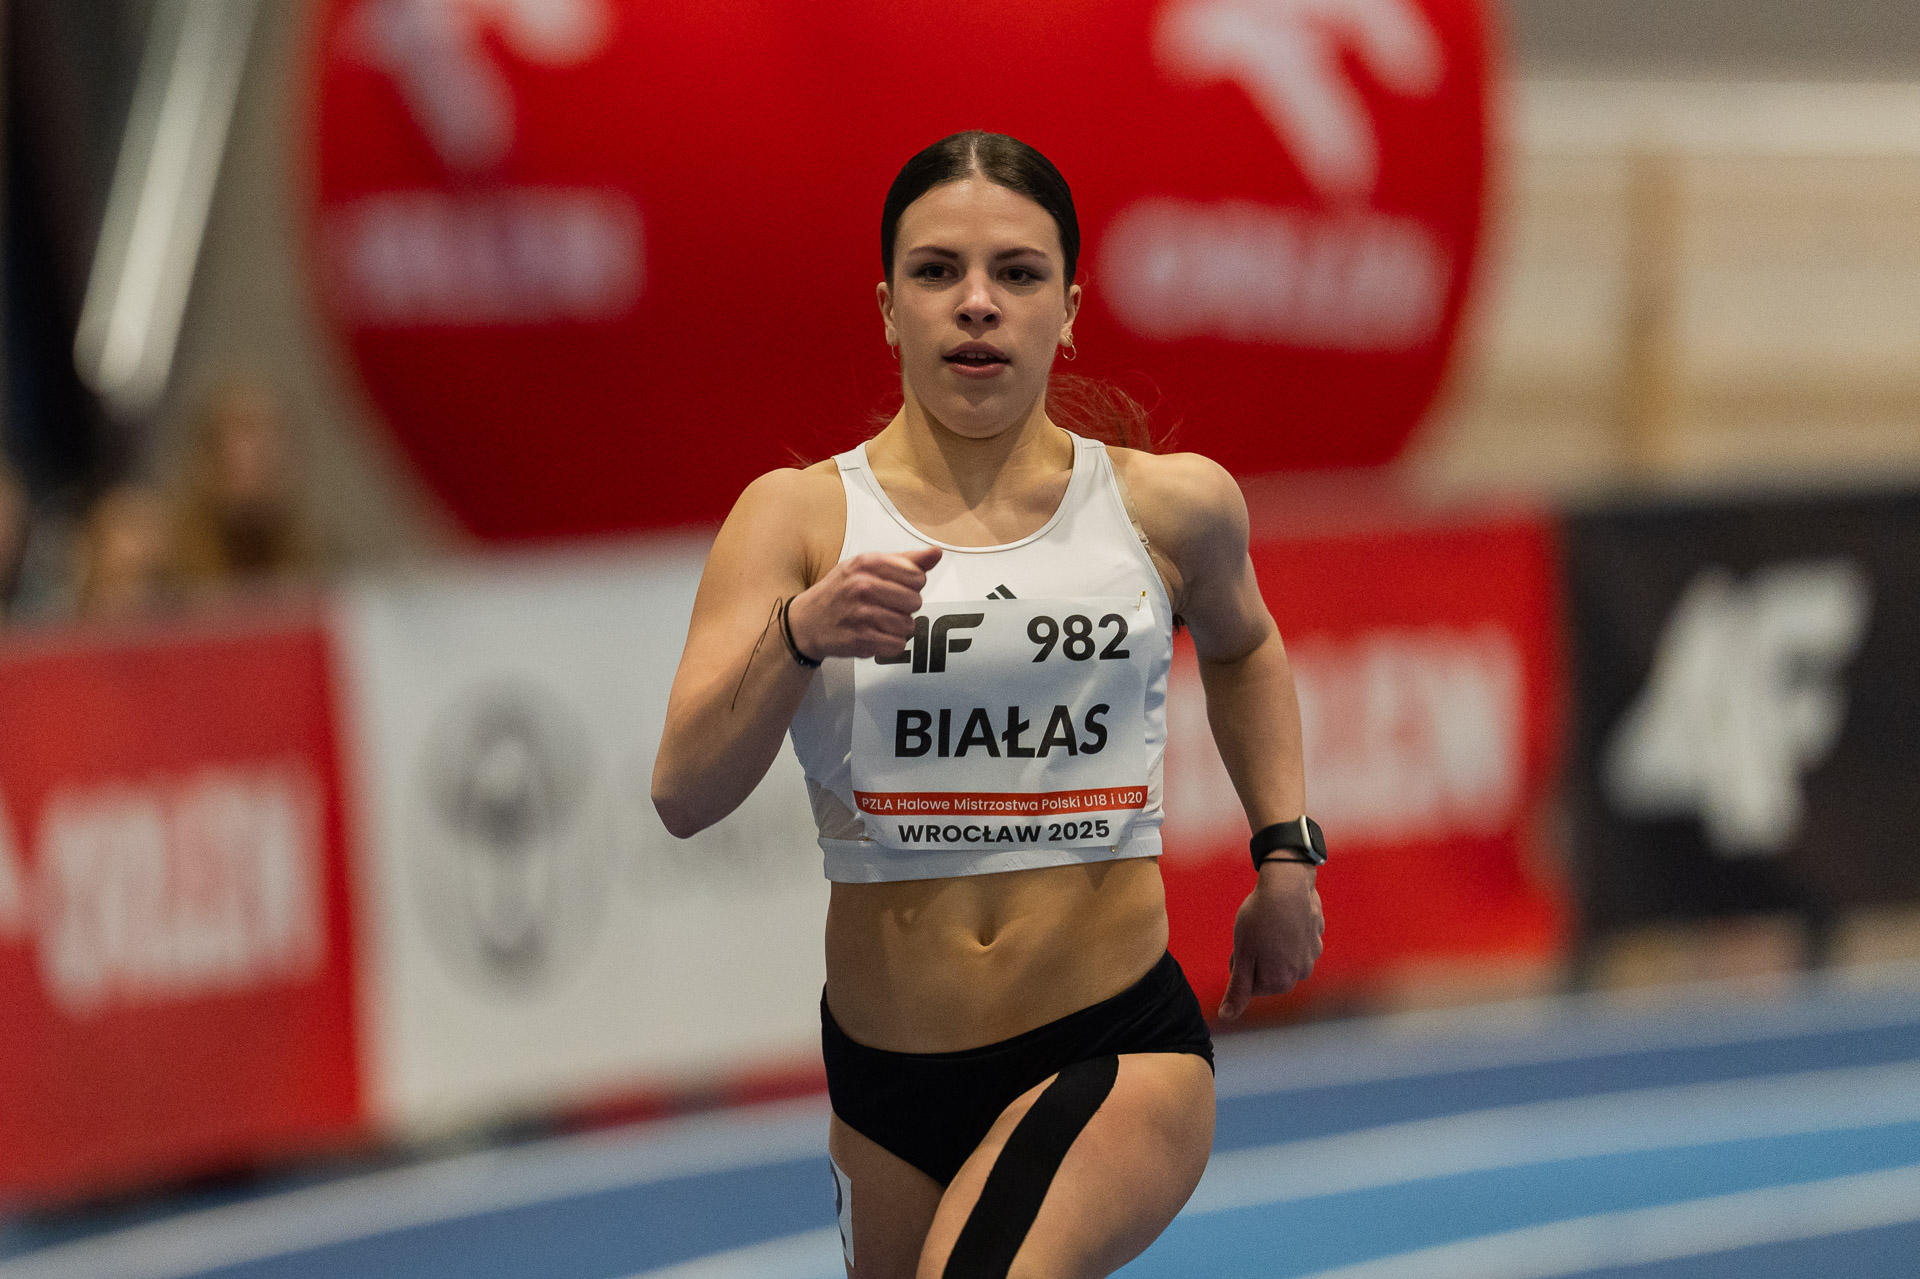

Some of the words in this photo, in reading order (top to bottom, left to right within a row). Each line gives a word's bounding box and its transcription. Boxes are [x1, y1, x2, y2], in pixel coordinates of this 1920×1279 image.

[1027, 613, 1130, 663] 982
[894, 703, 1110, 758] BIAŁAS
[861, 797, 893, 810] PZLA
[897, 798, 950, 810] Halowe
[954, 798, 1038, 811] Mistrzostwa
[1041, 795, 1080, 810] Polski
[1083, 794, 1107, 807] U18
[1110, 793, 1115, 805] i
[1118, 791, 1143, 805] U20
[898, 824, 1041, 843] WROCŁAW
[1048, 819, 1110, 841] 2025
